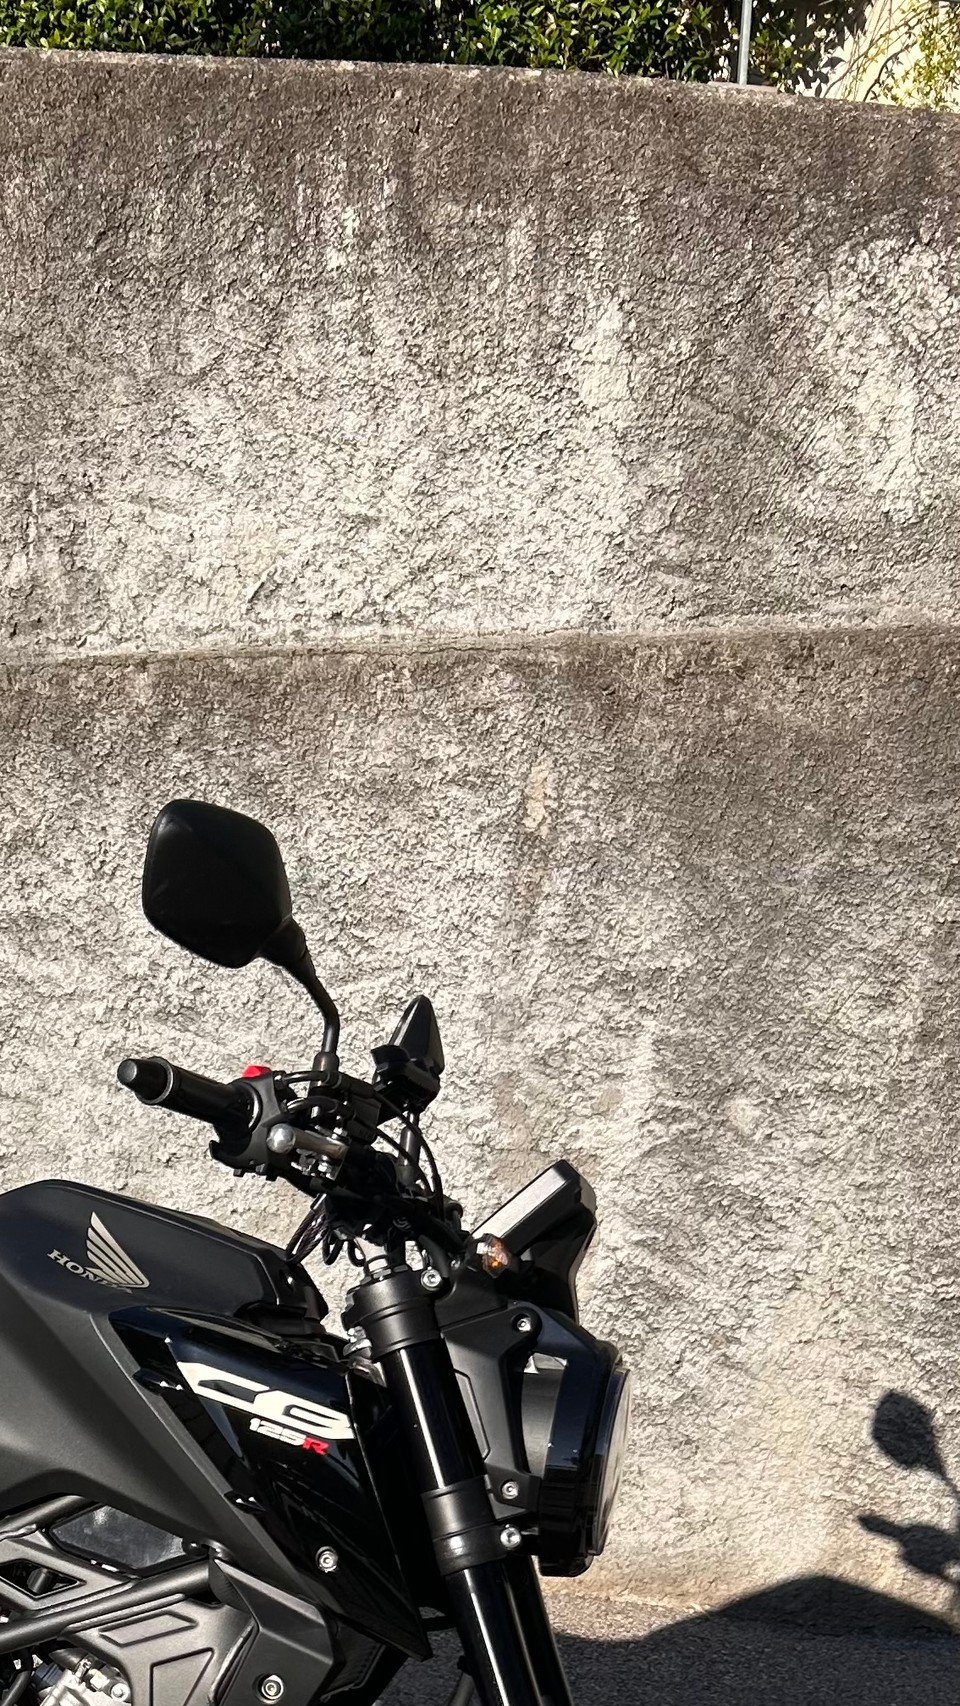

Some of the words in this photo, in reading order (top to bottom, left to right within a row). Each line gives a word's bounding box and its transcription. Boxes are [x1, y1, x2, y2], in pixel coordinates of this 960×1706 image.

[47, 1249, 133, 1294] HON
[176, 1361, 357, 1440] CB
[249, 1417, 330, 1456] 125R
